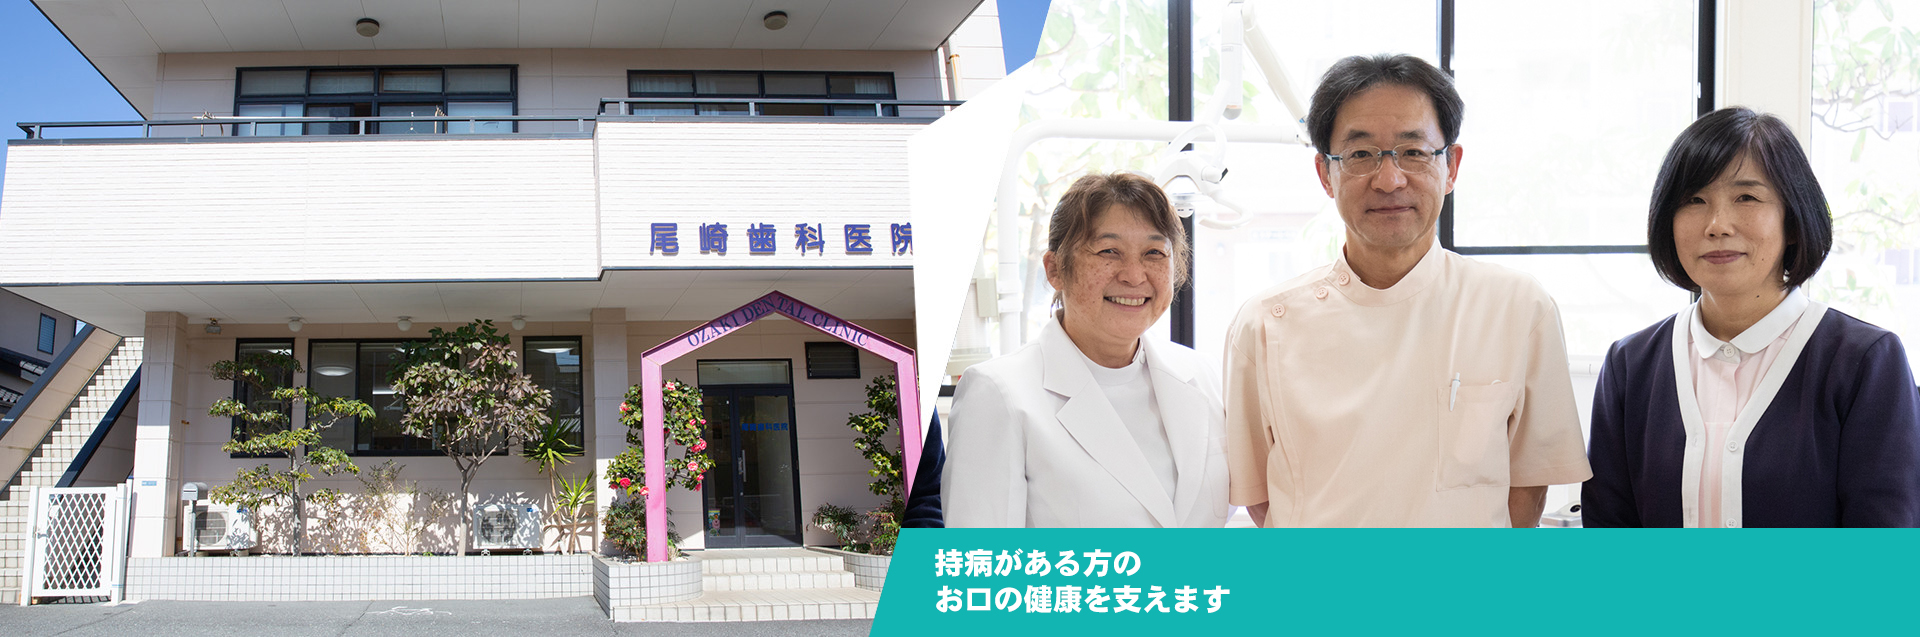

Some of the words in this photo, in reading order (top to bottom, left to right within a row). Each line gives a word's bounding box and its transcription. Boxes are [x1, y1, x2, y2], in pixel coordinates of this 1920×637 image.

[650, 222, 913, 255] 尾崎歯科医院
[687, 315, 740, 346] OZAKI
[741, 296, 806, 323] DENTAL
[812, 312, 869, 346] CLINIC
